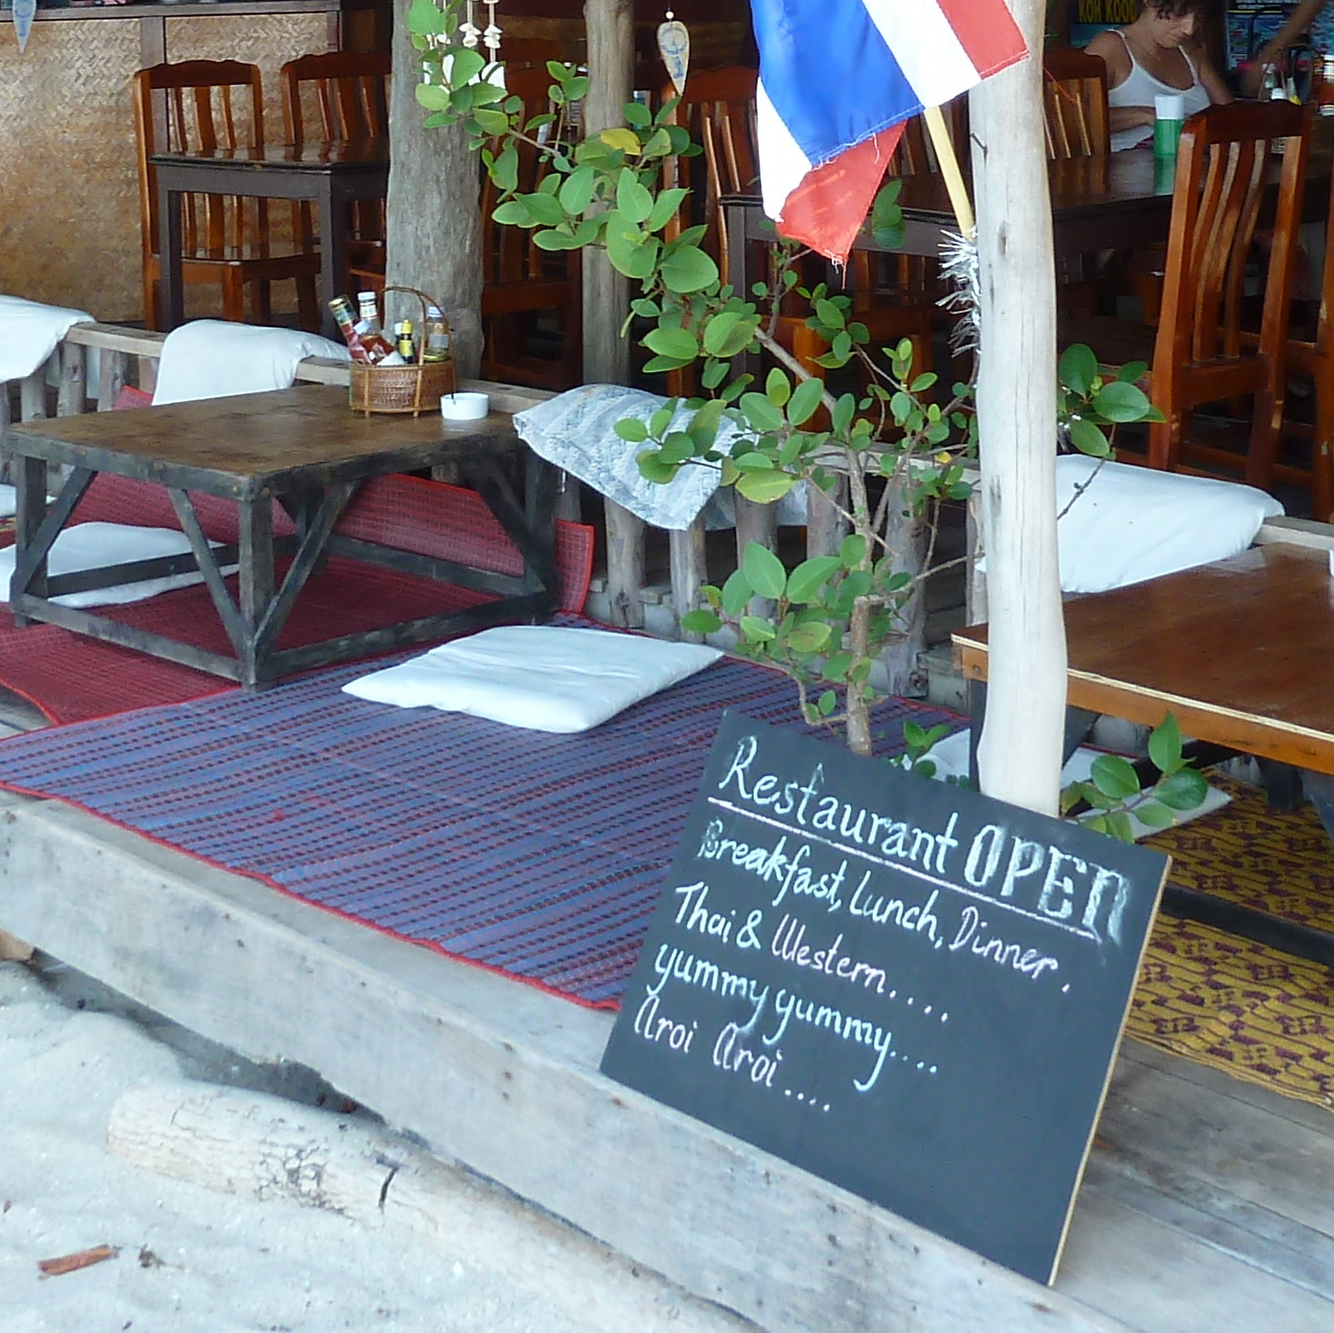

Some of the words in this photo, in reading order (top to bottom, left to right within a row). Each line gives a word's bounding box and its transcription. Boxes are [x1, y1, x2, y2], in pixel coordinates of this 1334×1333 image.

[718, 735, 958, 873] Restaurant
[675, 882, 732, 938] Thai
[734, 909, 762, 950] &
[849, 871, 944, 950] Lunch,
[647, 944, 768, 1033] yummy
